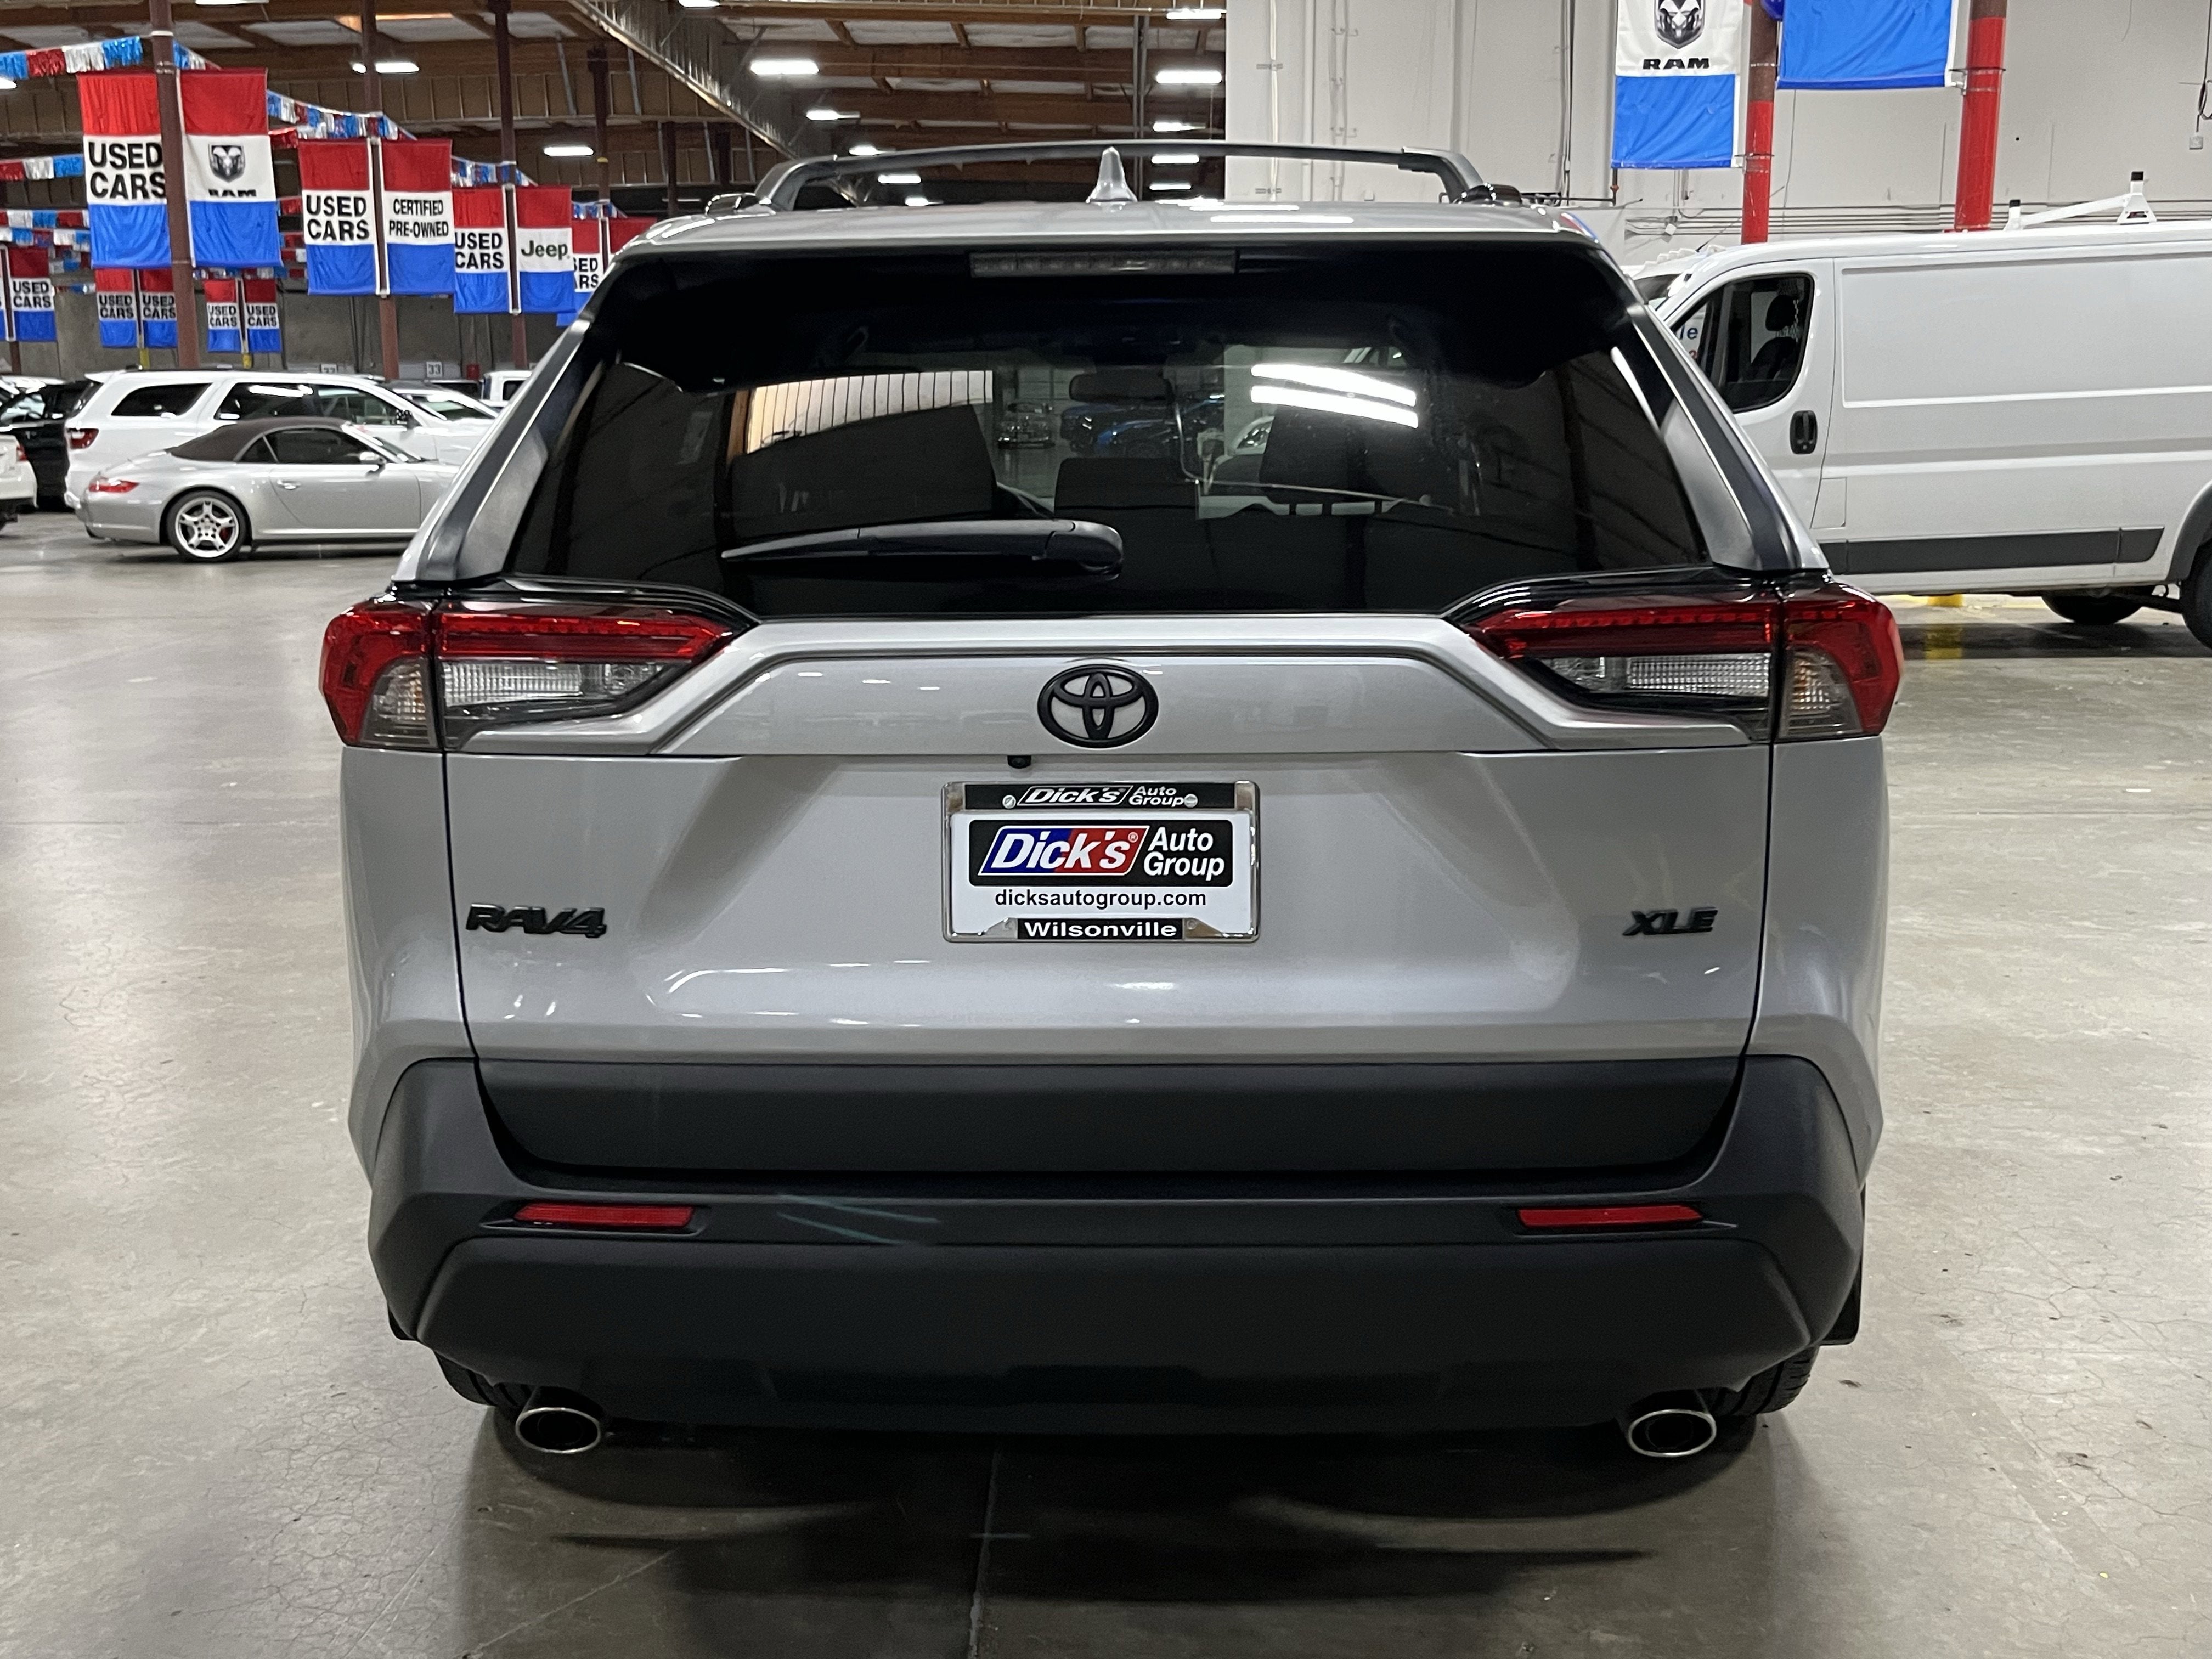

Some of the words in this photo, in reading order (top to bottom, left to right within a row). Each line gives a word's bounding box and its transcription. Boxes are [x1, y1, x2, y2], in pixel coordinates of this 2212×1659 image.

[1643, 58, 1709, 70] RAM
[88, 142, 163, 169] USED
[89, 171, 165, 199] CARS
[208, 189, 257, 197] RAM
[306, 195, 366, 217] USED
[393, 199, 444, 216] CERTIFIED
[307, 218, 370, 241] CARS
[389, 219, 449, 238] PRE-OWNED
[455, 232, 503, 250] USED
[521, 240, 568, 261] Jeep
[455, 251, 505, 269] CARS
[13, 281, 49, 294] USED
[13, 295, 52, 308] CARS
[99, 294, 133, 307] USED
[143, 295, 174, 306] USED
[100, 307, 134, 319] CARS
[143, 307, 176, 319] CARS
[209, 305, 236, 315] USED
[247, 305, 276, 315] USED
[210, 317, 238, 328] CARS
[247, 317, 278, 328] CARS
[1133, 786, 1177, 796] Auto
[1128, 794, 1185, 808] Group
[1147, 826, 1214, 852] Auto
[1143, 851, 1225, 882] Group
[995, 889, 1207, 910] dicksautogroup.com
[466, 903, 607, 938] RAV4
[1622, 907, 1718, 936] XLE
[1024, 921, 1178, 938] Wilsonville
